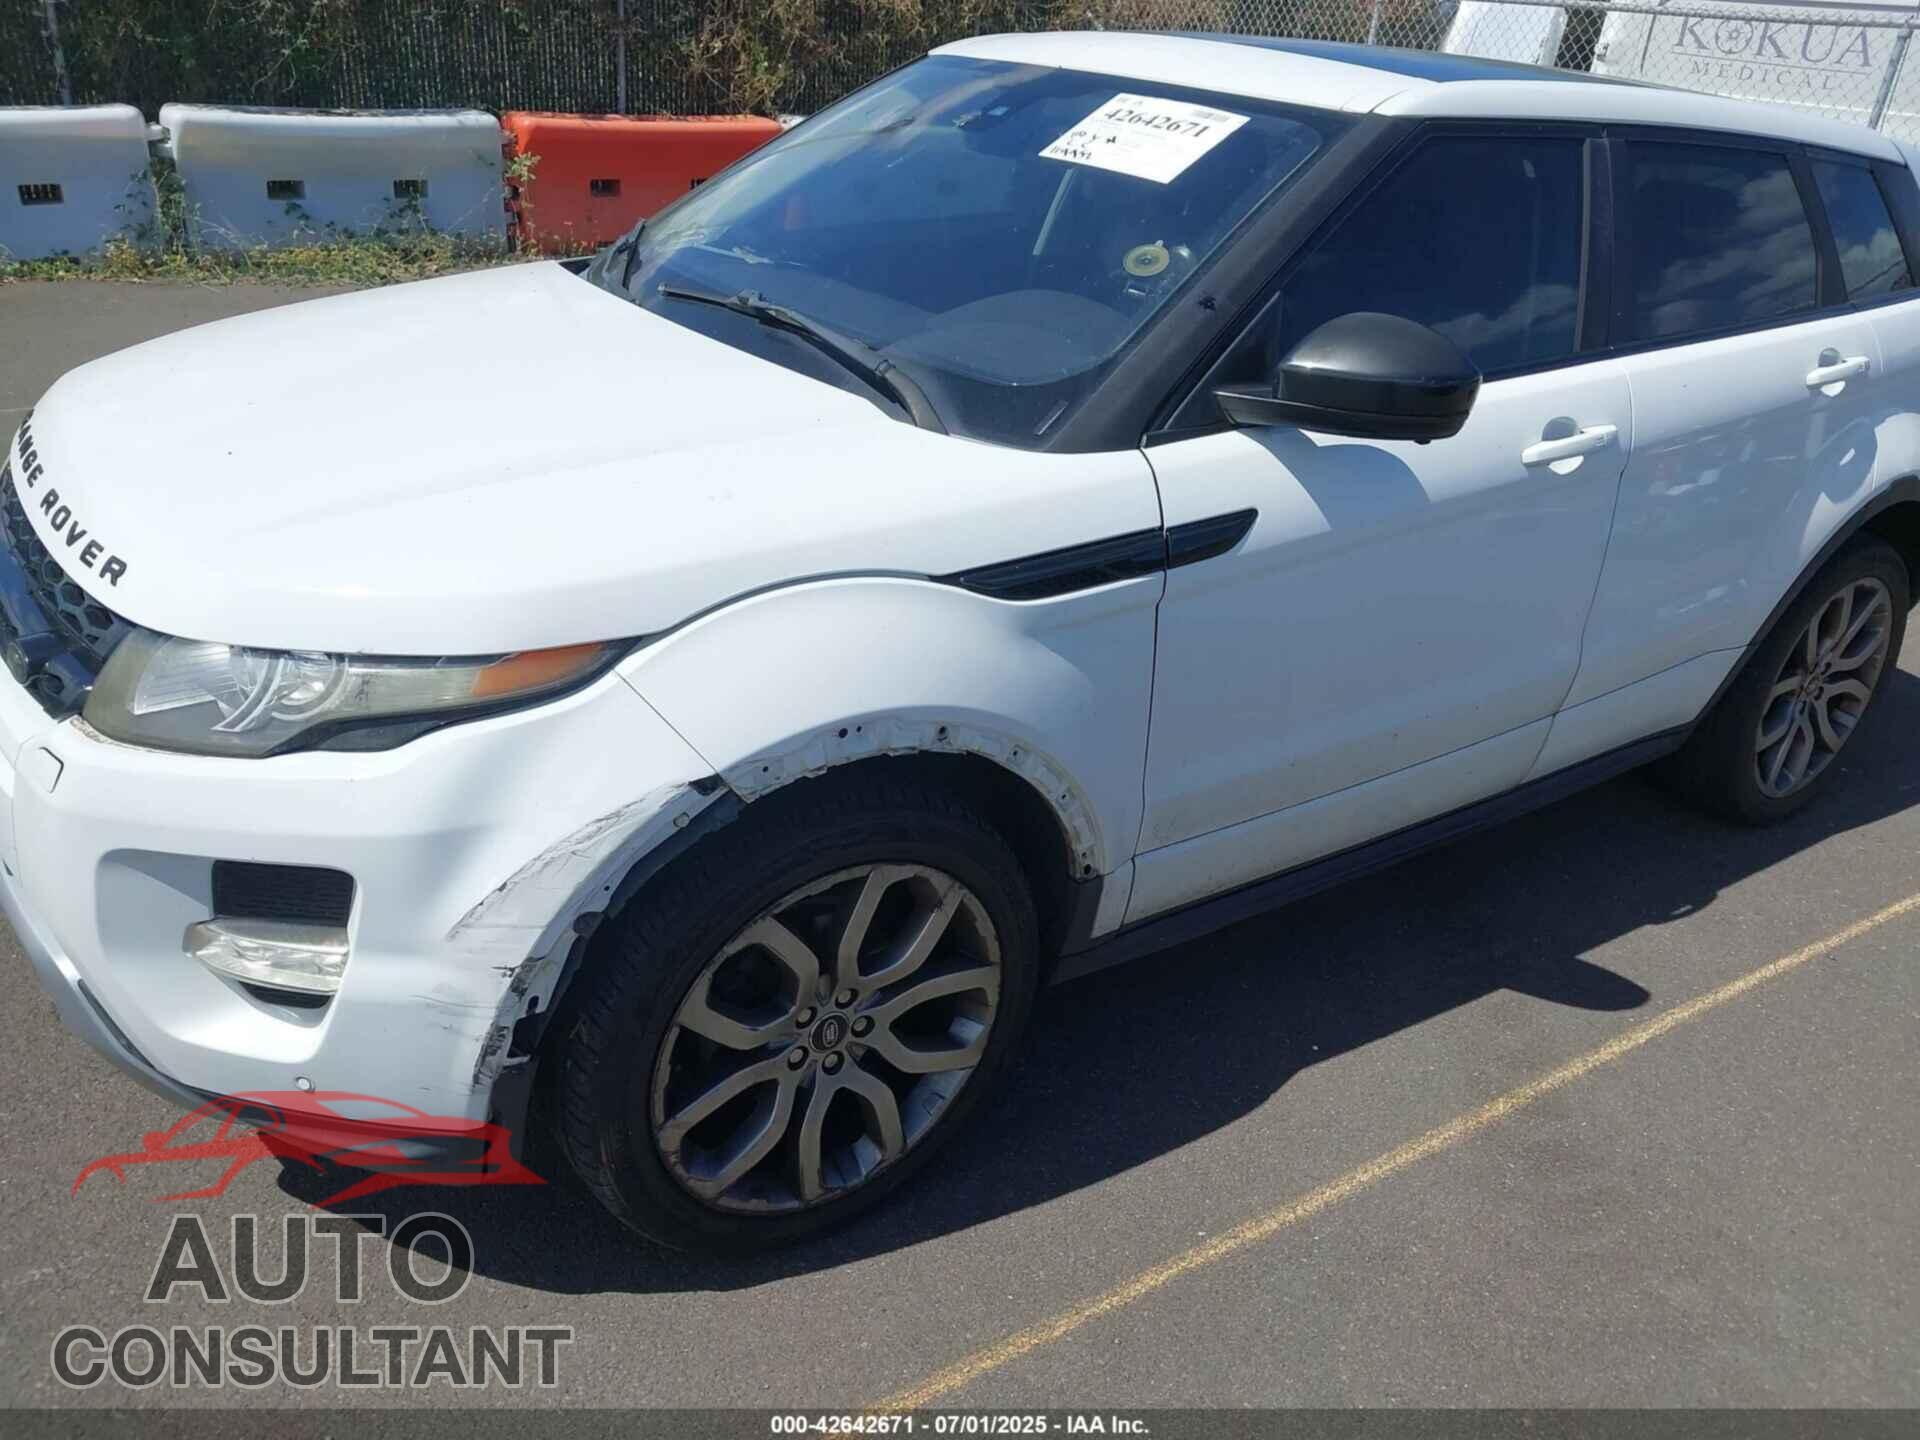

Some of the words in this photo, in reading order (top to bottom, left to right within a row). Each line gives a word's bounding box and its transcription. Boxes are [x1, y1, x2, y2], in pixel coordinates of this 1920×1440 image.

[1672, 15, 1873, 67] KOKUA
[1690, 61, 1835, 90] MEDICAL
[1105, 108, 1211, 138] 42642671
[40, 488, 127, 586] ROVER
